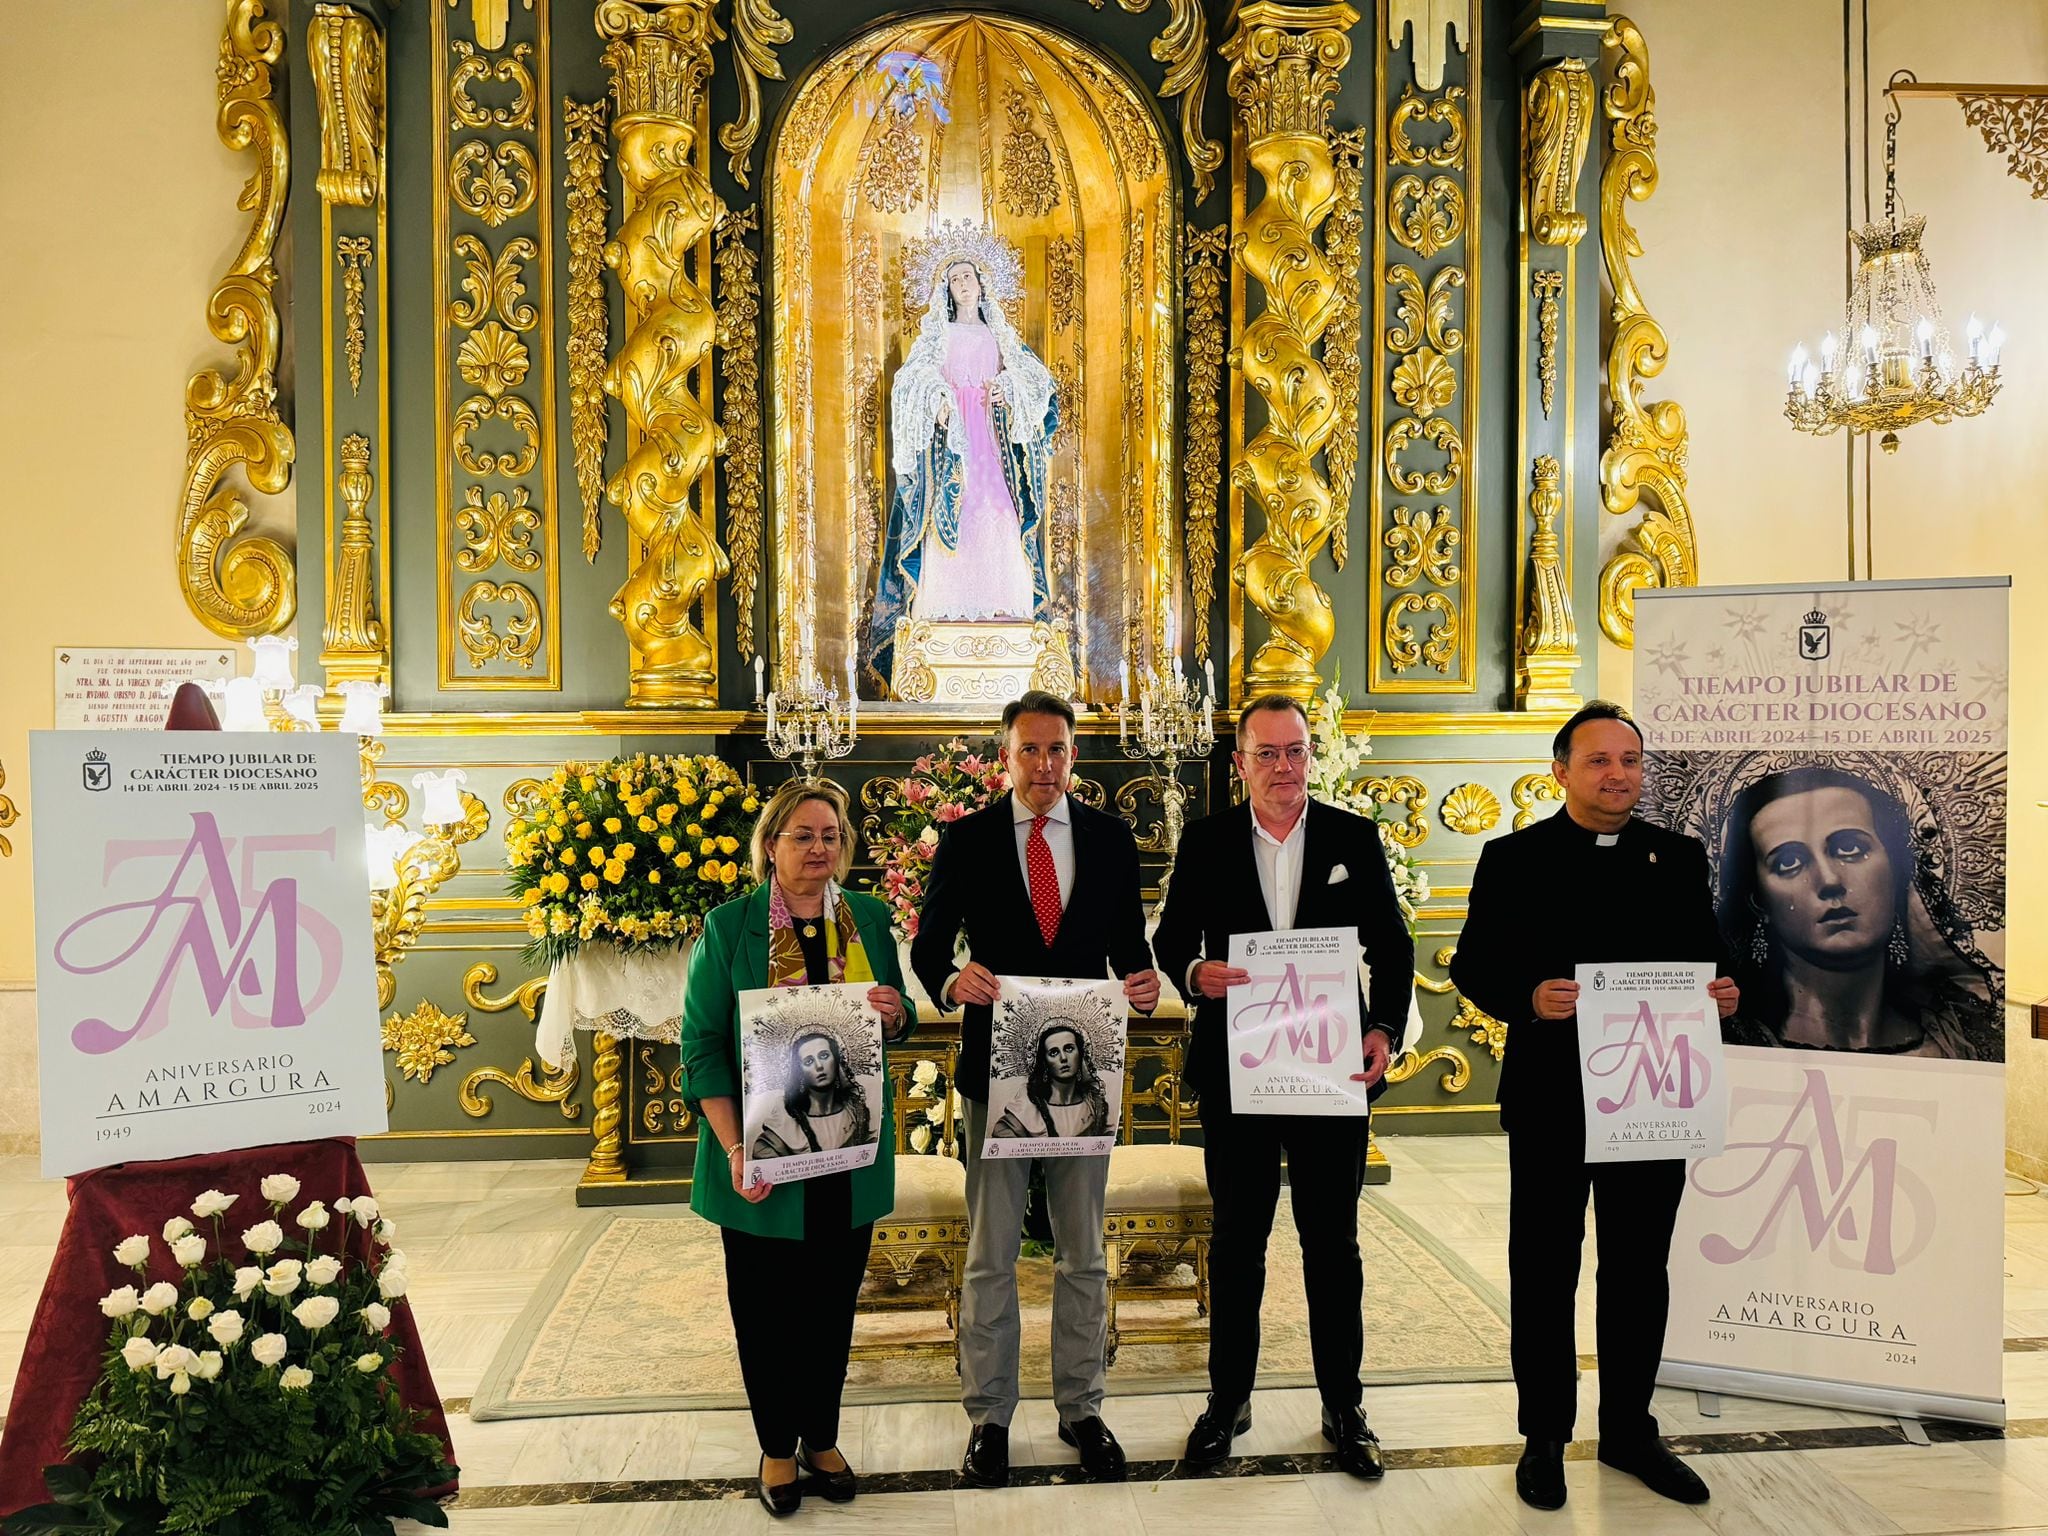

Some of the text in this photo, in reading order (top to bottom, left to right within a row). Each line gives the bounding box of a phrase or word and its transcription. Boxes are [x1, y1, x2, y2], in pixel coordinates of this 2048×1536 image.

[181, 658, 192, 666] AÑO
[76, 677, 93, 686] NTRA.
[98, 678, 111, 686] SRA.
[116, 678, 124, 687] LA
[128, 678, 151, 687] VIRGEN
[1679, 673, 1958, 698] TIEMPO JUBILAR DE
[113, 691, 136, 699] OBISPO
[1653, 699, 1987, 722] CARÁCTER DIOCESANO
[83, 714, 90, 722] D.
[1649, 730, 1665, 743] 14
[1671, 730, 1695, 743] DE
[1700, 730, 1756, 743] ABRIL
[1761, 730, 1806, 743] 2024
[1823, 730, 1840, 743] 15
[1847, 730, 1873, 743] DE
[1878, 730, 1938, 743] ABRIL
[1944, 729, 1992, 744] 2025
[160, 753, 317, 766] TIEMPO JUBILAR DE
[130, 766, 318, 780] CARÁCTER DIOCESANO
[123, 784, 134, 792] 14
[138, 784, 153, 792] DE
[156, 783, 191, 792] ABRIL
[193, 783, 220, 791] 2024
[229, 783, 239, 791] 15
[242, 783, 257, 791] DE
[259, 783, 292, 791] ABRIL
[294, 782, 319, 790] 2025
[145, 1053, 295, 1083] ANIVERSARIO
[107, 1069, 331, 1112] AMARGURA
[308, 1100, 342, 1115] 2024
[1625, 1120, 1688, 1129] ANIVERSARIO
[96, 1126, 131, 1142] 1949
[1609, 1129, 1703, 1140] AMARGURA
[1747, 1290, 1874, 1316] ANIVERSARIO
[1716, 1304, 1906, 1340] AMARGURA
[1708, 1330, 1736, 1342] 1949
[1885, 1352, 1917, 1365] 2024
